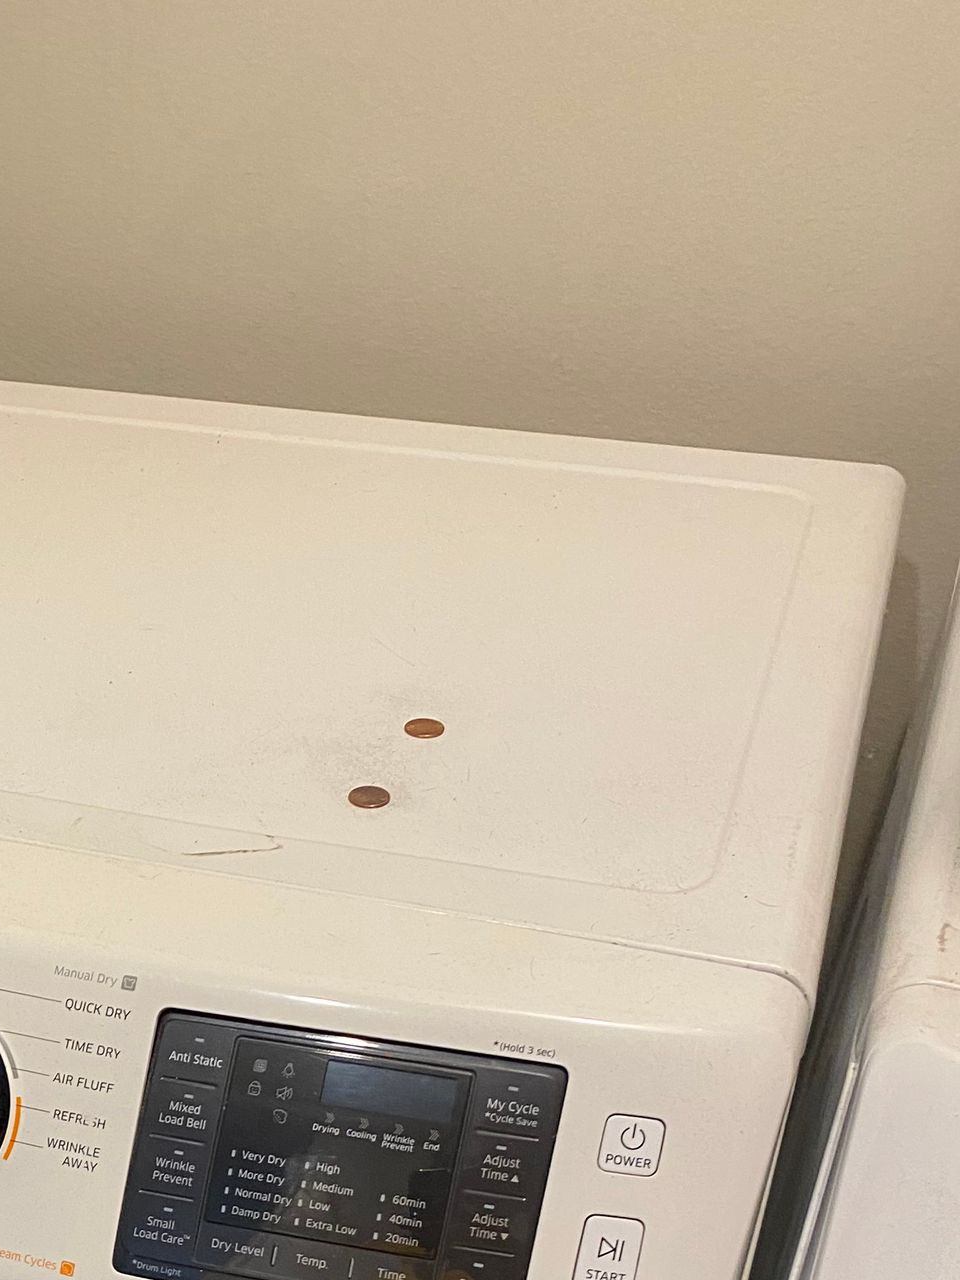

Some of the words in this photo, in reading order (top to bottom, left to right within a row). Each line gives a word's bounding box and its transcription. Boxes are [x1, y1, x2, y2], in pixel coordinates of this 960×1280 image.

[54, 965, 94, 982] Manual
[97, 973, 118, 988] Dry
[65, 998, 103, 1015] QUICK
[105, 1007, 131, 1021] DRY
[65, 1038, 94, 1054] TIME
[96, 1045, 121, 1060] DRY
[528, 1046, 534, 1055] 3
[536, 1048, 556, 1058] sec)
[169, 1050, 191, 1063] Anti
[193, 1054, 224, 1068] Static
[53, 1072, 73, 1086] AIR
[76, 1077, 115, 1094] FLUFF
[169, 1101, 201, 1115] Mixed
[487, 1098, 506, 1112] My
[508, 1101, 540, 1116] Cycle
[159, 1113, 183, 1126] Load
[186, 1117, 206, 1130] Bell
[516, 1116, 538, 1128] Save
[312, 1123, 340, 1136] Drying
[346, 1128, 377, 1142] Cooling
[383, 1133, 415, 1145] Wrinkle
[423, 1141, 440, 1152] End
[47, 1137, 101, 1158] WRINKLE
[381, 1141, 413, 1153] Prevent
[62, 1156, 98, 1172] AWAY
[155, 1156, 196, 1173] Wrinkle
[242, 1150, 265, 1164] Very
[268, 1154, 287, 1168] Dry
[483, 1154, 521, 1170] Adjust
[605, 1154, 652, 1169] POWER
[316, 1162, 341, 1176] High
[480, 1168, 509, 1181] Time
[152, 1171, 192, 1187] Prevent
[238, 1168, 264, 1182] More
[266, 1172, 285, 1186] Dry
[312, 1181, 354, 1196] Medium
[234, 1187, 271, 1202] Normal
[273, 1193, 292, 1207] Dry
[392, 1195, 426, 1210] 60min
[309, 1200, 330, 1212] Low
[231, 1205, 260, 1220] Damp
[262, 1211, 282, 1225] Dry
[389, 1214, 423, 1229] 40min
[472, 1212, 510, 1229] Adjust
[147, 1216, 175, 1230] Small
[306, 1219, 333, 1232] Extra
[335, 1224, 357, 1236] Low
[133, 1227, 158, 1241] Load
[385, 1232, 419, 1247] 20min
[470, 1226, 497, 1240] Time
[211, 1238, 232, 1252] Dry
[235, 1242, 264, 1257] Level
[24, 1254, 56, 1271] Cycles
[296, 1254, 329, 1269] Temp.
[160, 1265, 182, 1278] Light
